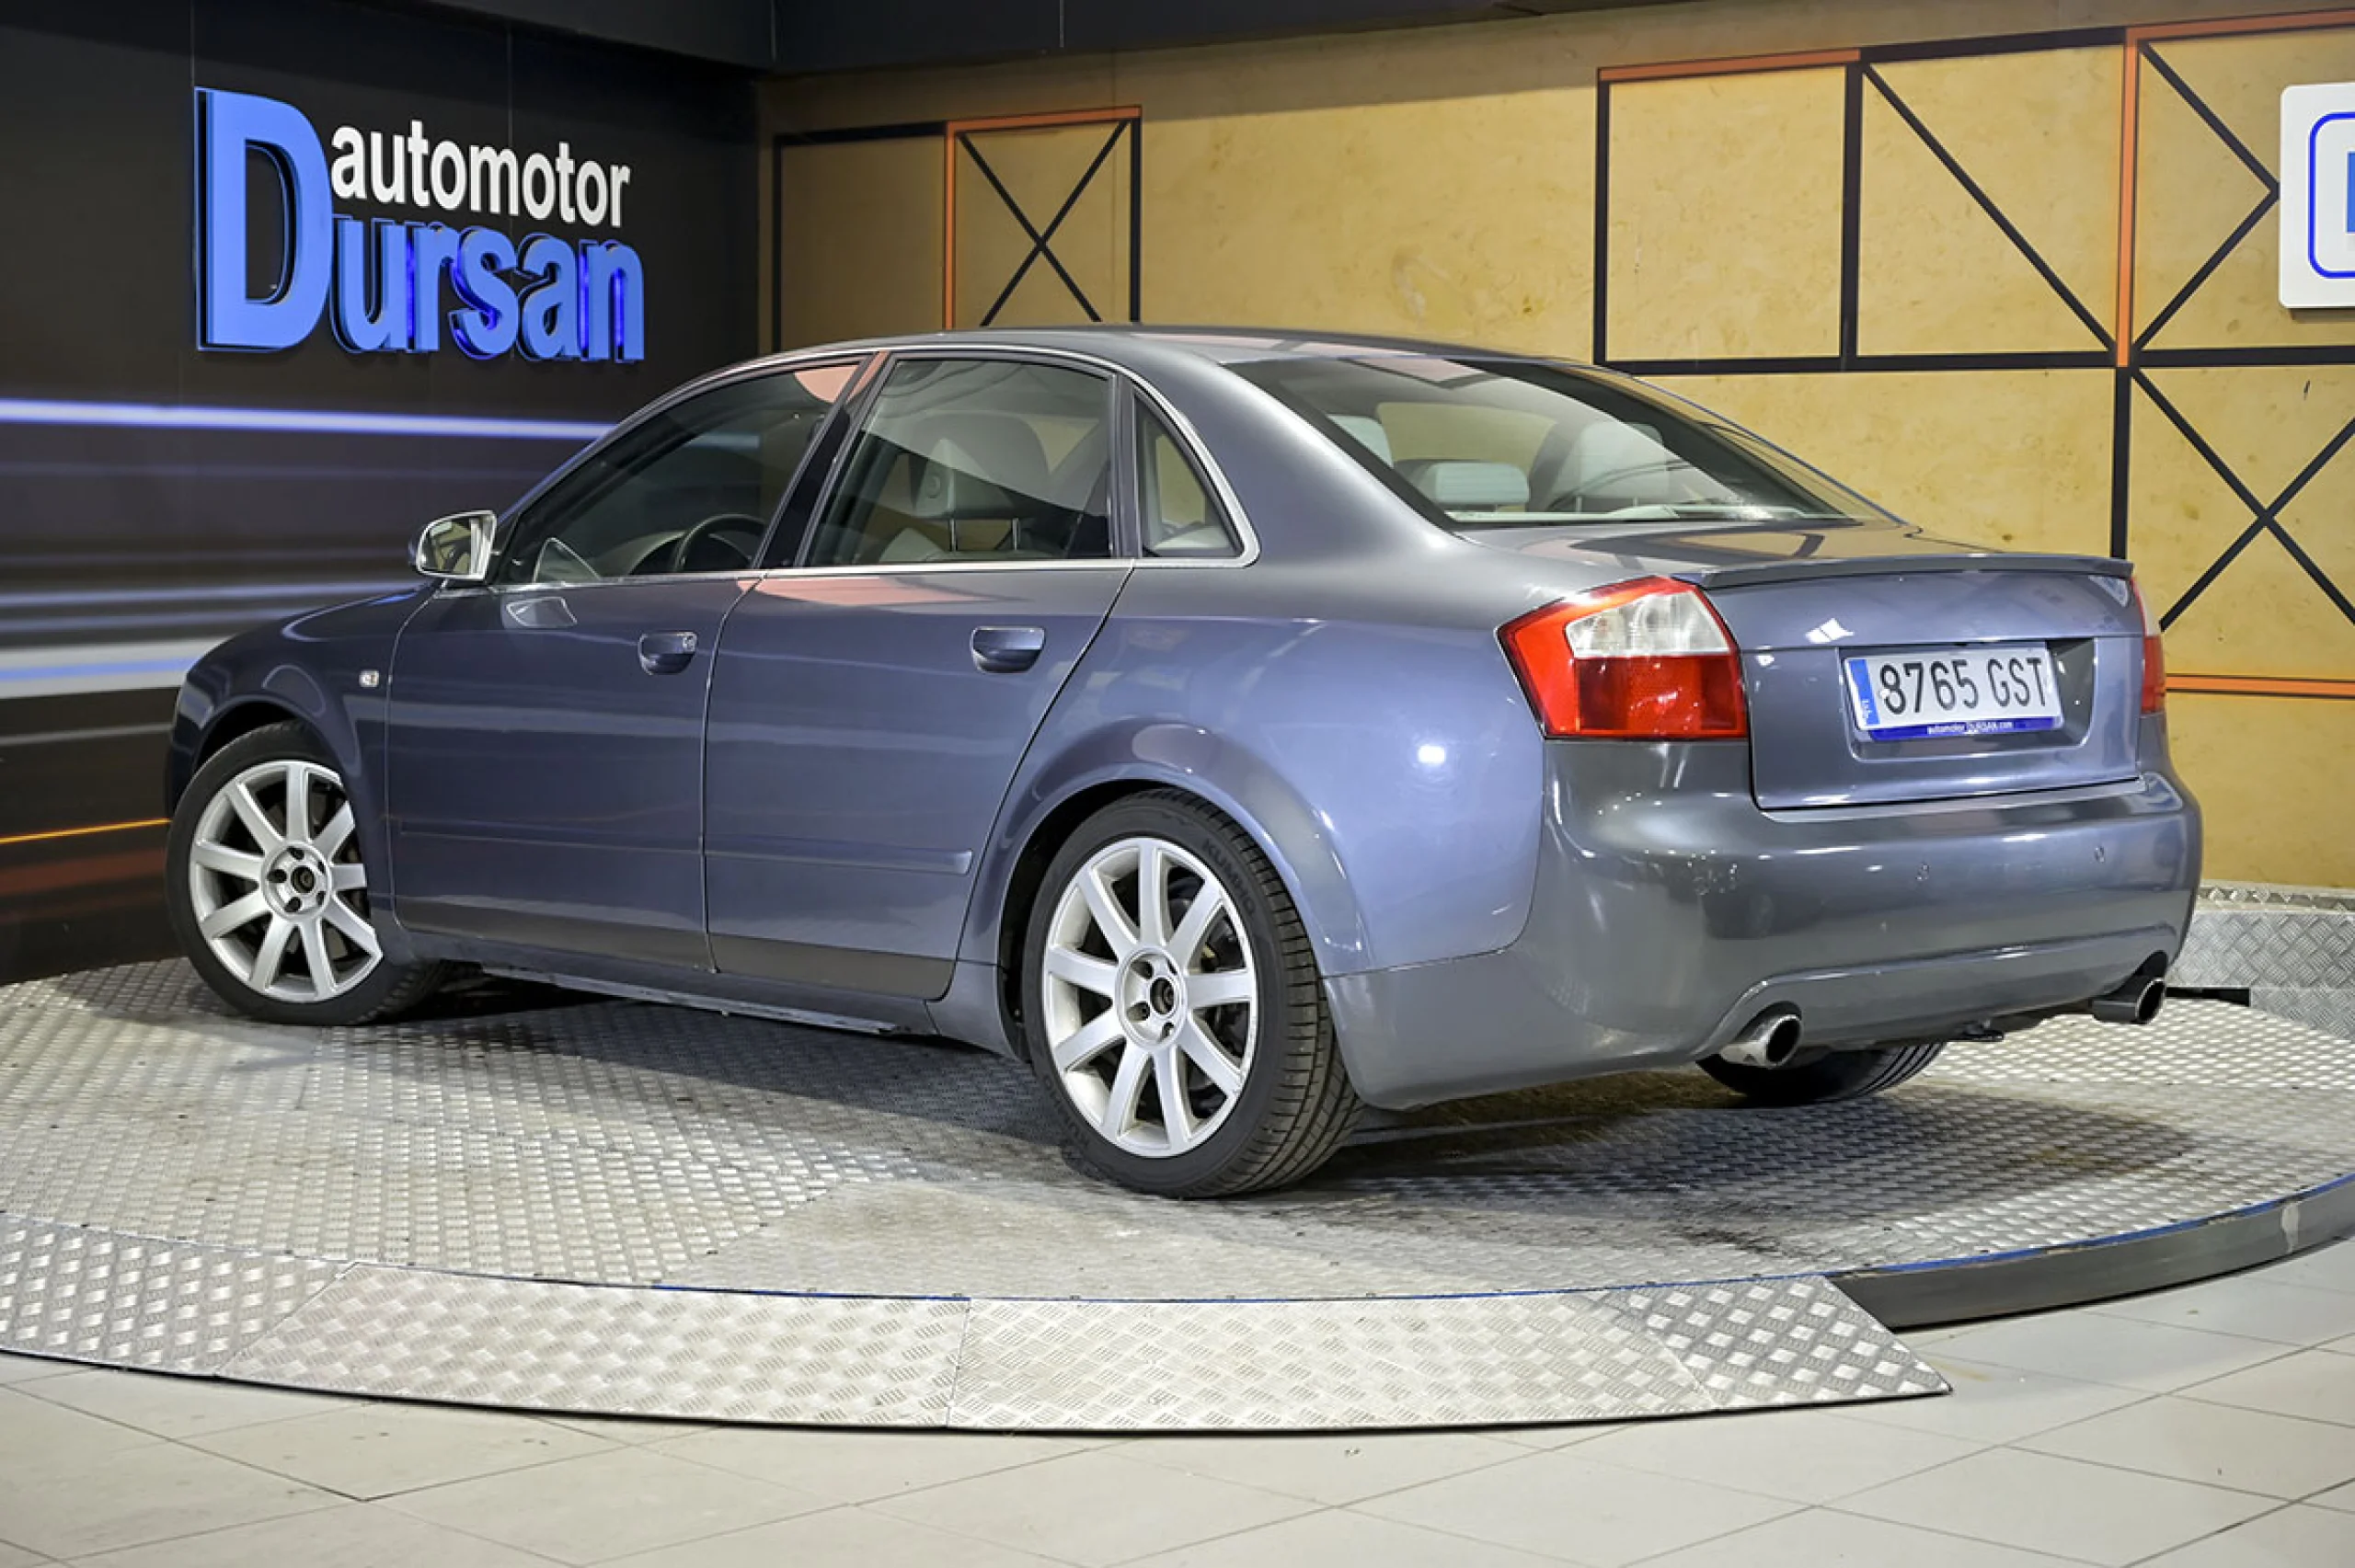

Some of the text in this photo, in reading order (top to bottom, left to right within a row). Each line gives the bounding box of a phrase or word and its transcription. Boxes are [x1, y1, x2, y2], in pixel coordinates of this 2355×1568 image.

[331, 120, 630, 227] automotor
[194, 86, 645, 362] Dursan
[1878, 659, 1979, 715] 8765
[1987, 657, 2048, 707] GST
[1201, 838, 1256, 914] KUMHO
